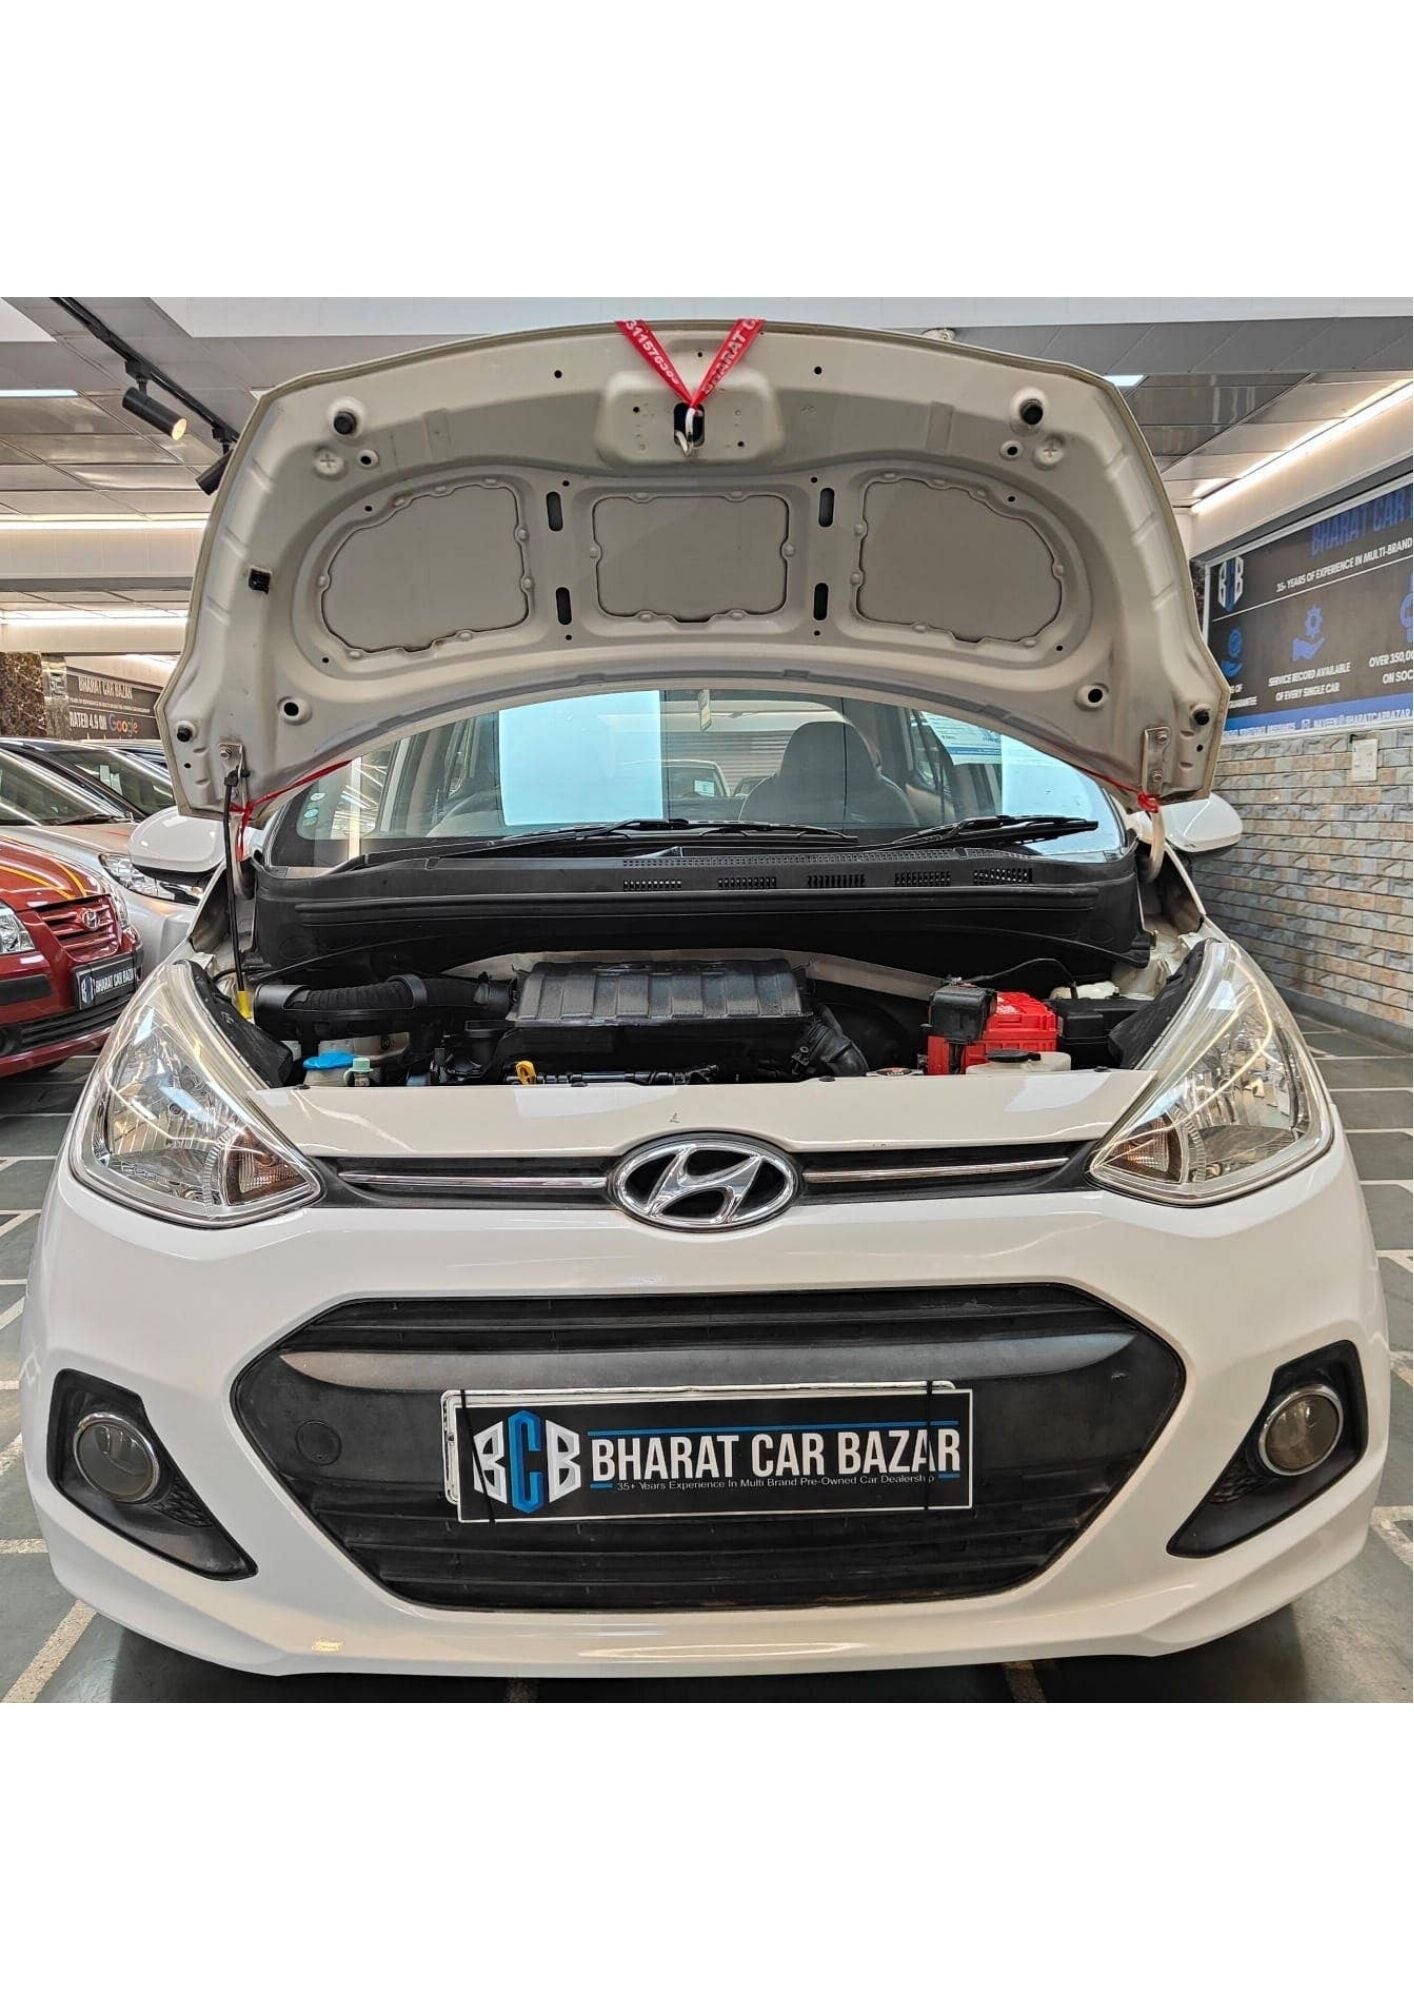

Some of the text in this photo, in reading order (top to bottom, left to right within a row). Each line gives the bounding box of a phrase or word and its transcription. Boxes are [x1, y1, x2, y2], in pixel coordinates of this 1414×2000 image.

[1311, 508, 1367, 556] BHARAT
[1287, 573, 1306, 589] YEARS
[1306, 571, 1317, 582] OF
[1316, 557, 1354, 578] EXPERIENCE
[1354, 554, 1363, 565] IN
[1292, 669, 1316, 683] RECORD
[1316, 662, 1351, 680] AVAILABLE
[1369, 654, 1389, 668] OVER
[1382, 672, 1394, 684] ON
[1302, 685, 1325, 698] SINGLE
[1325, 682, 1340, 694] CAR
[69, 712, 89, 728] RATED
[108, 714, 139, 737] Google
[473, 1410, 582, 1514] BCB
[591, 1428, 961, 1482] BHARAT CAR BAZAR
[617, 1472, 936, 1492] 35+ Years Experience In Multi Brand Pre-Owned Car Dealershp
